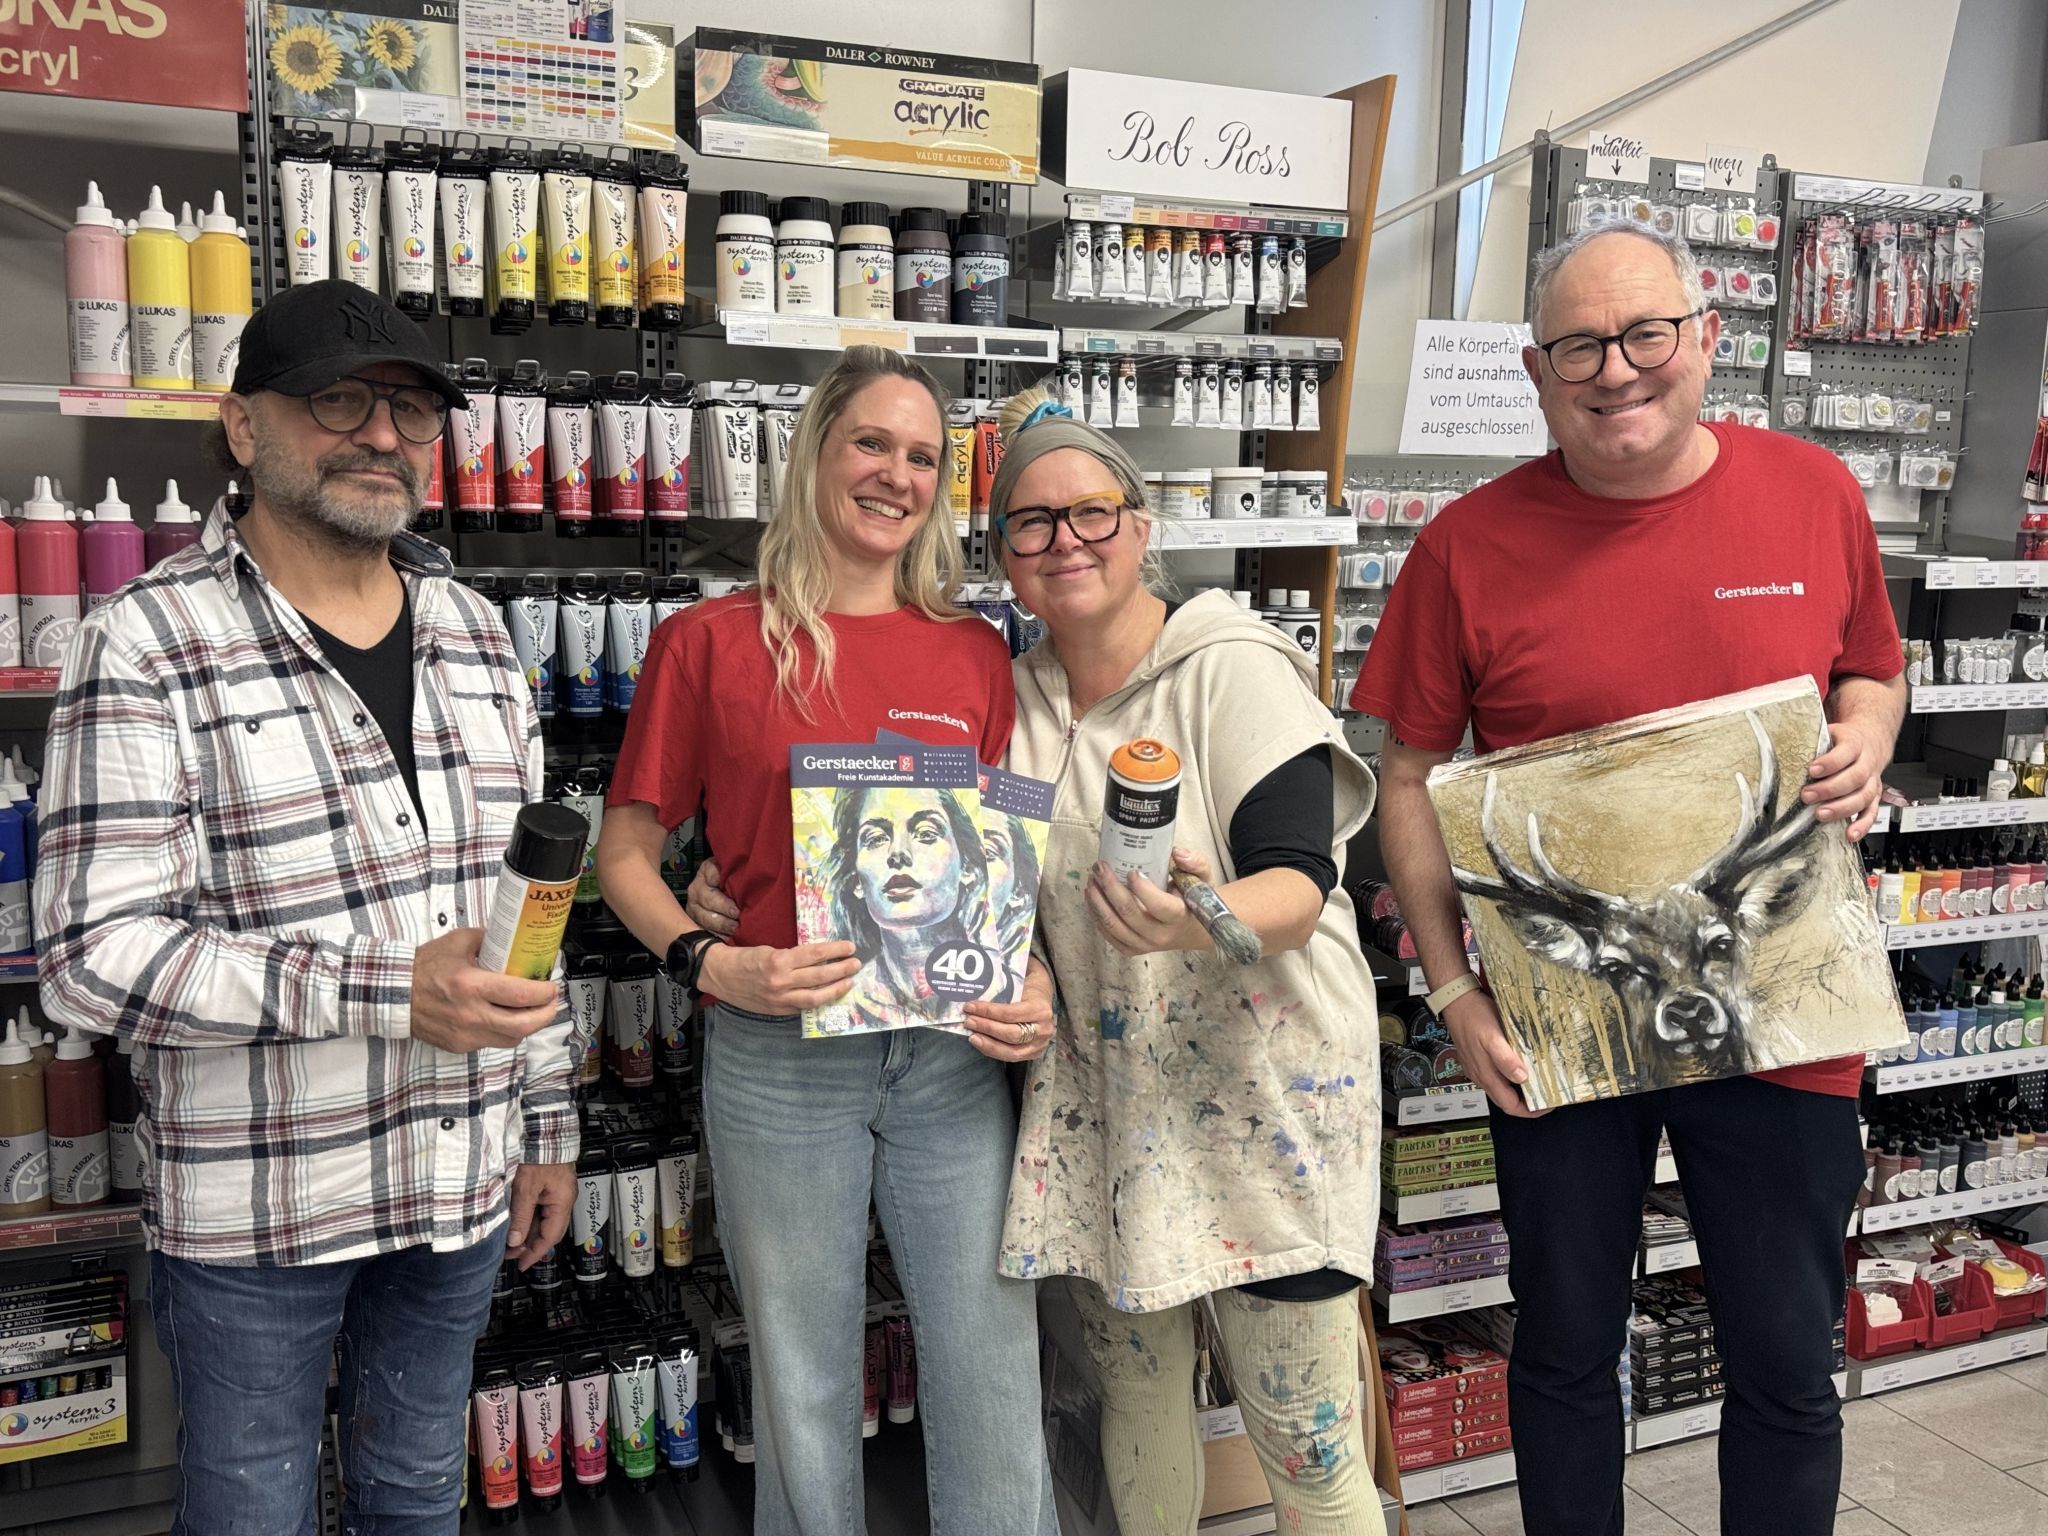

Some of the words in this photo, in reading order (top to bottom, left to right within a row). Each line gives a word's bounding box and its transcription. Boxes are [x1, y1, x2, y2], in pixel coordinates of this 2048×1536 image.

[422, 3, 459, 18] DALE
[826, 46, 866, 61] DALER
[884, 53, 936, 69] ROWNEY
[903, 79, 984, 98] GRADUATE
[894, 100, 990, 136] acrylic
[1107, 111, 1195, 167] Bob
[1204, 121, 1290, 177] Ross
[916, 151, 943, 162] VALUE
[947, 154, 982, 164] ACRYLIC
[1708, 155, 1744, 176] neon
[86, 301, 118, 312] LUKAS
[145, 306, 176, 316] LUKAS
[198, 315, 226, 325] LUKAS
[1427, 335, 1454, 352] Alle
[1423, 363, 1453, 380] sind
[1430, 394, 1461, 407] vom
[1466, 392, 1533, 408] Umtausch
[1421, 418, 1535, 438] ausgeschlossen!
[1714, 582, 1792, 599] Gerstaecker
[888, 708, 962, 729] Gerstaecker
[803, 755, 897, 771] Gerstaecker
[837, 773, 856, 781] Freie
[858, 773, 914, 782] Kunstakademie
[1120, 793, 1162, 812] Liquitex
[1118, 811, 1136, 822] SPRAY
[529, 886, 575, 901] JAXE
[932, 948, 985, 981] 40
[1399, 1140, 1437, 1153] FANTASY
[1398, 1165, 1437, 1177] FANTASY
[13, 1317, 44, 1327] ROWNEY
[11, 1326, 42, 1336] ROWNEY
[13, 1362, 44, 1373] ROWNEY
[68, 1413, 101, 1425] Acrylic
